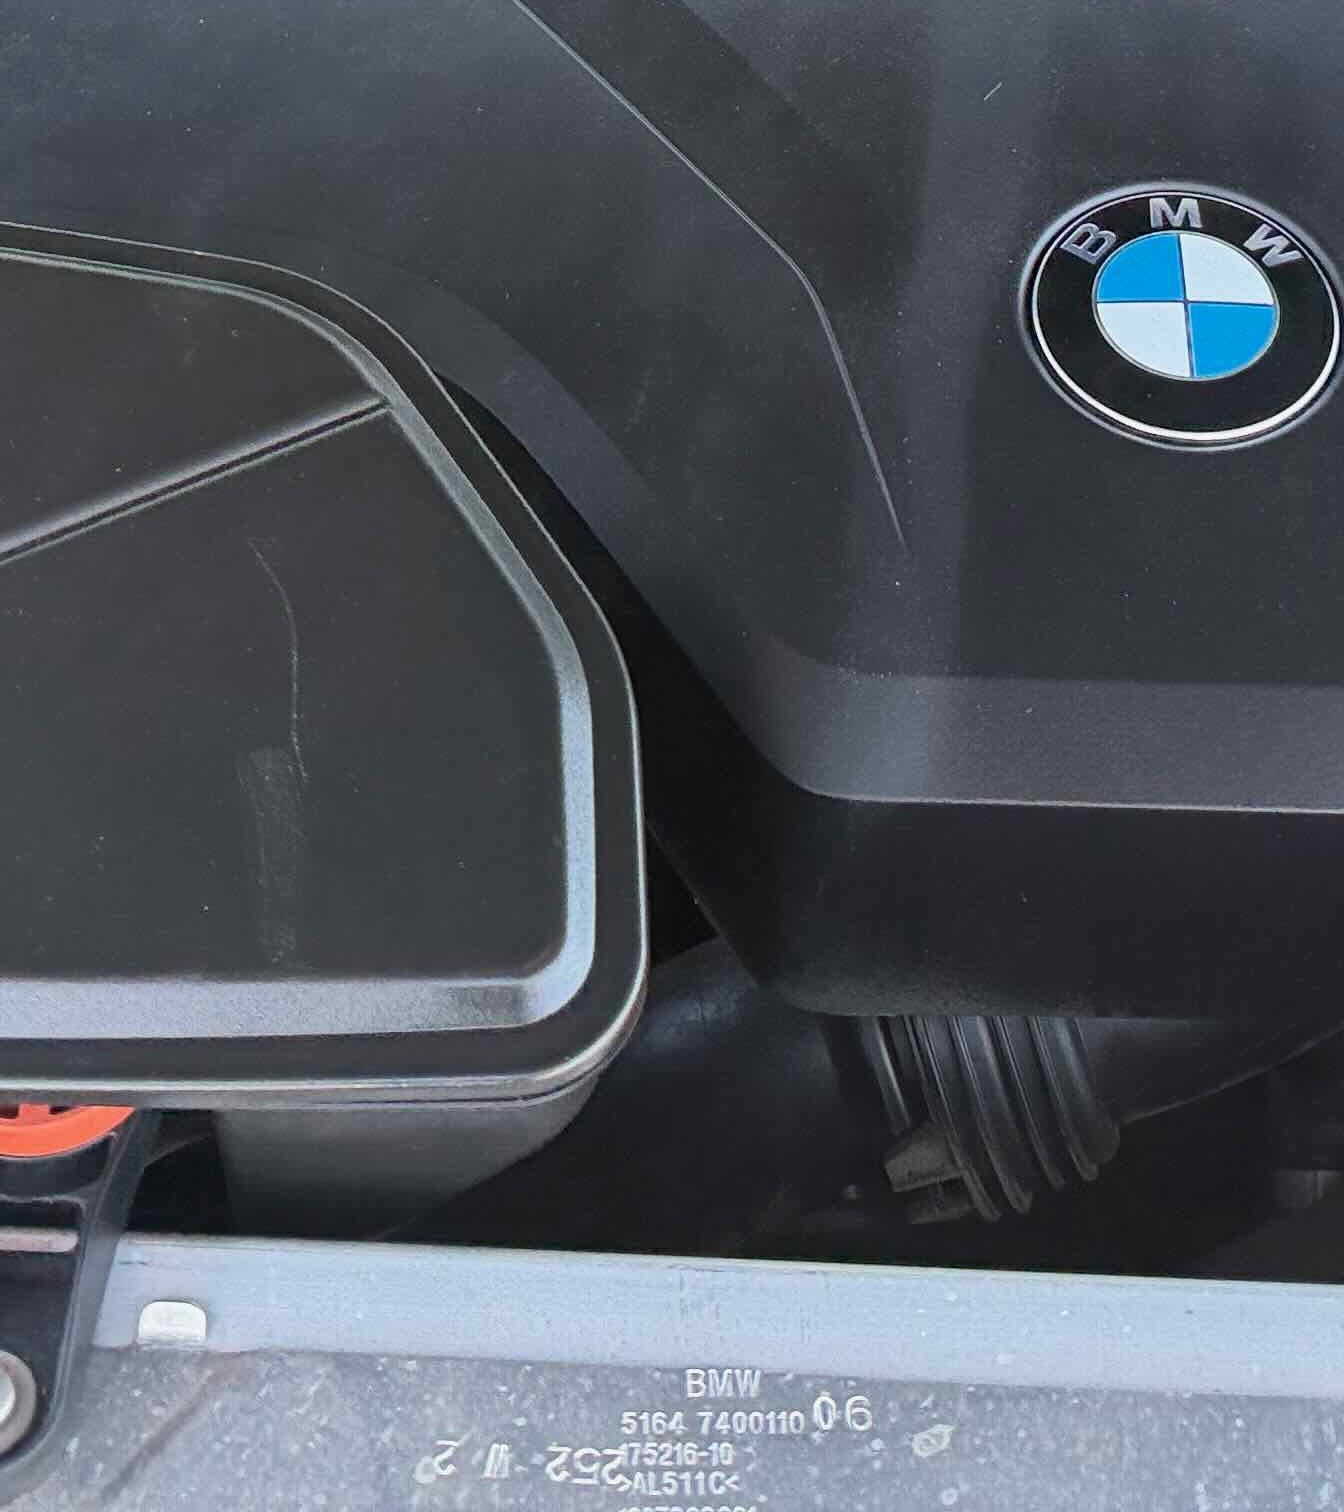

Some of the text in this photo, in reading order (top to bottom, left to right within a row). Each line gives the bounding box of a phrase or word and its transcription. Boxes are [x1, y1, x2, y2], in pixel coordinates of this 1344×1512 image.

[1059, 197, 1305, 269] BMW
[685, 1368, 763, 1398] BMW
[620, 1410, 688, 1435] 5164
[696, 1410, 805, 1435] 7400110
